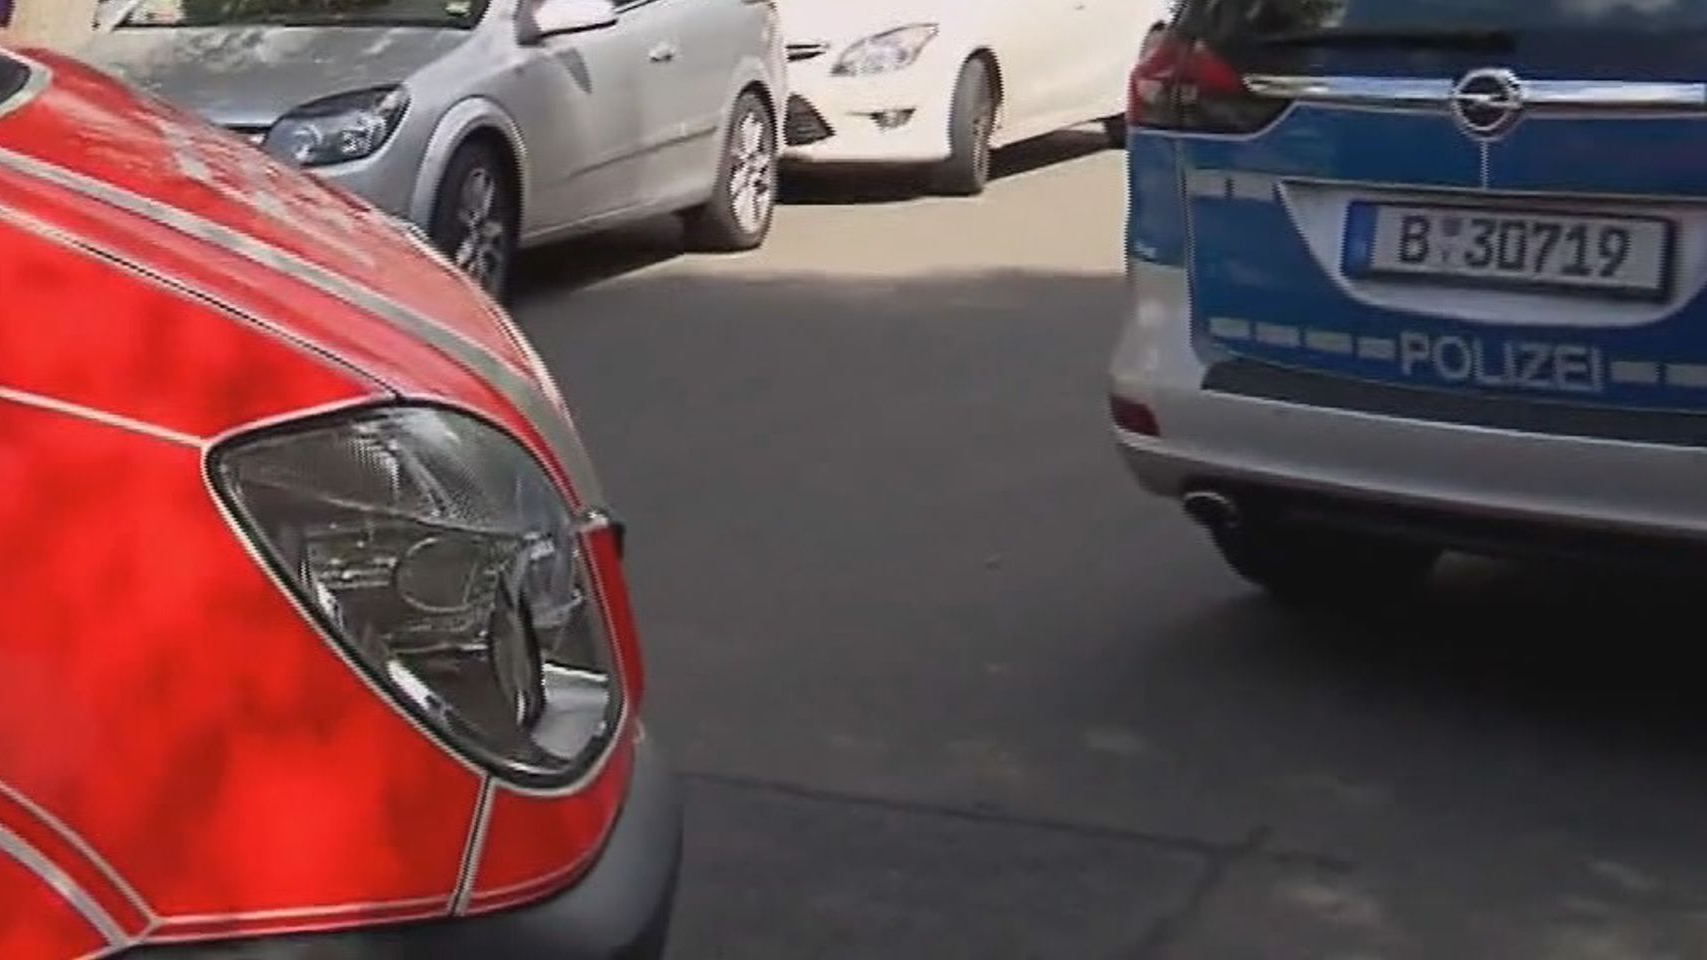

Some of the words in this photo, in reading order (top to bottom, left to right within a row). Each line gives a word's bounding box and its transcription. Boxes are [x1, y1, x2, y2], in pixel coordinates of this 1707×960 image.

[1398, 214, 1431, 265] B
[1464, 218, 1632, 278] 30719
[1400, 331, 1604, 393] POLIZEI
